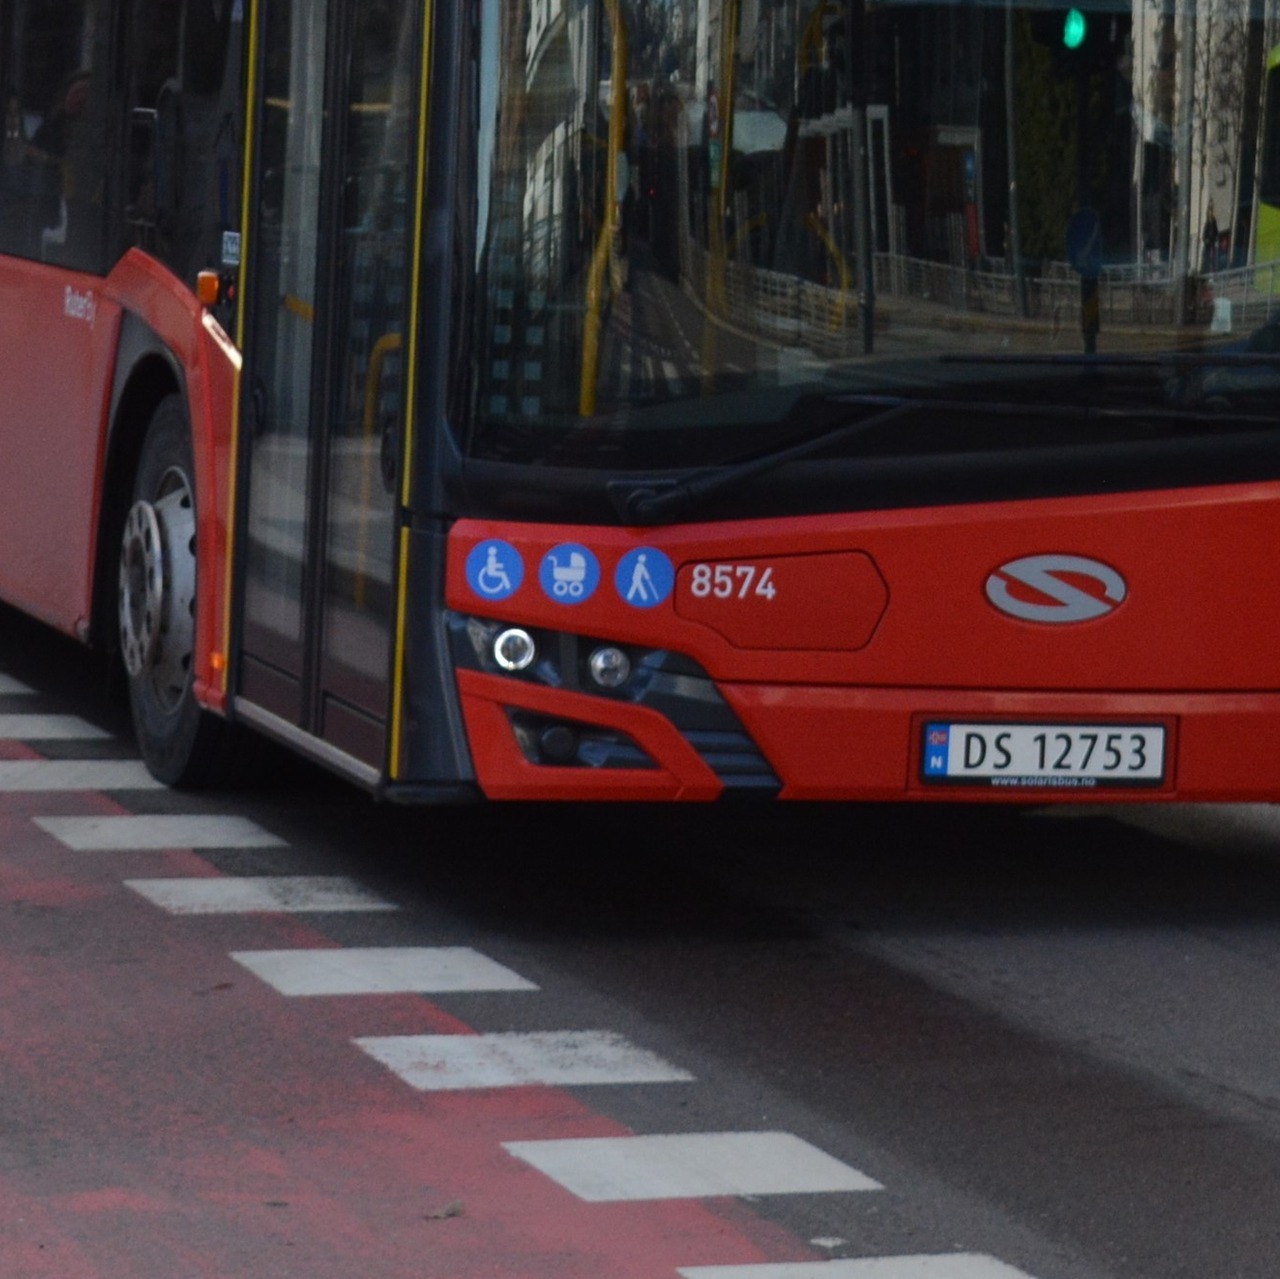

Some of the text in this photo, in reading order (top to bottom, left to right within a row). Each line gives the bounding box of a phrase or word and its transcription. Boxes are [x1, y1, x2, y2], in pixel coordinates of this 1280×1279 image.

[690, 563, 777, 601] 8574
[930, 755, 943, 769] N
[963, 732, 1148, 771] DS 12753
